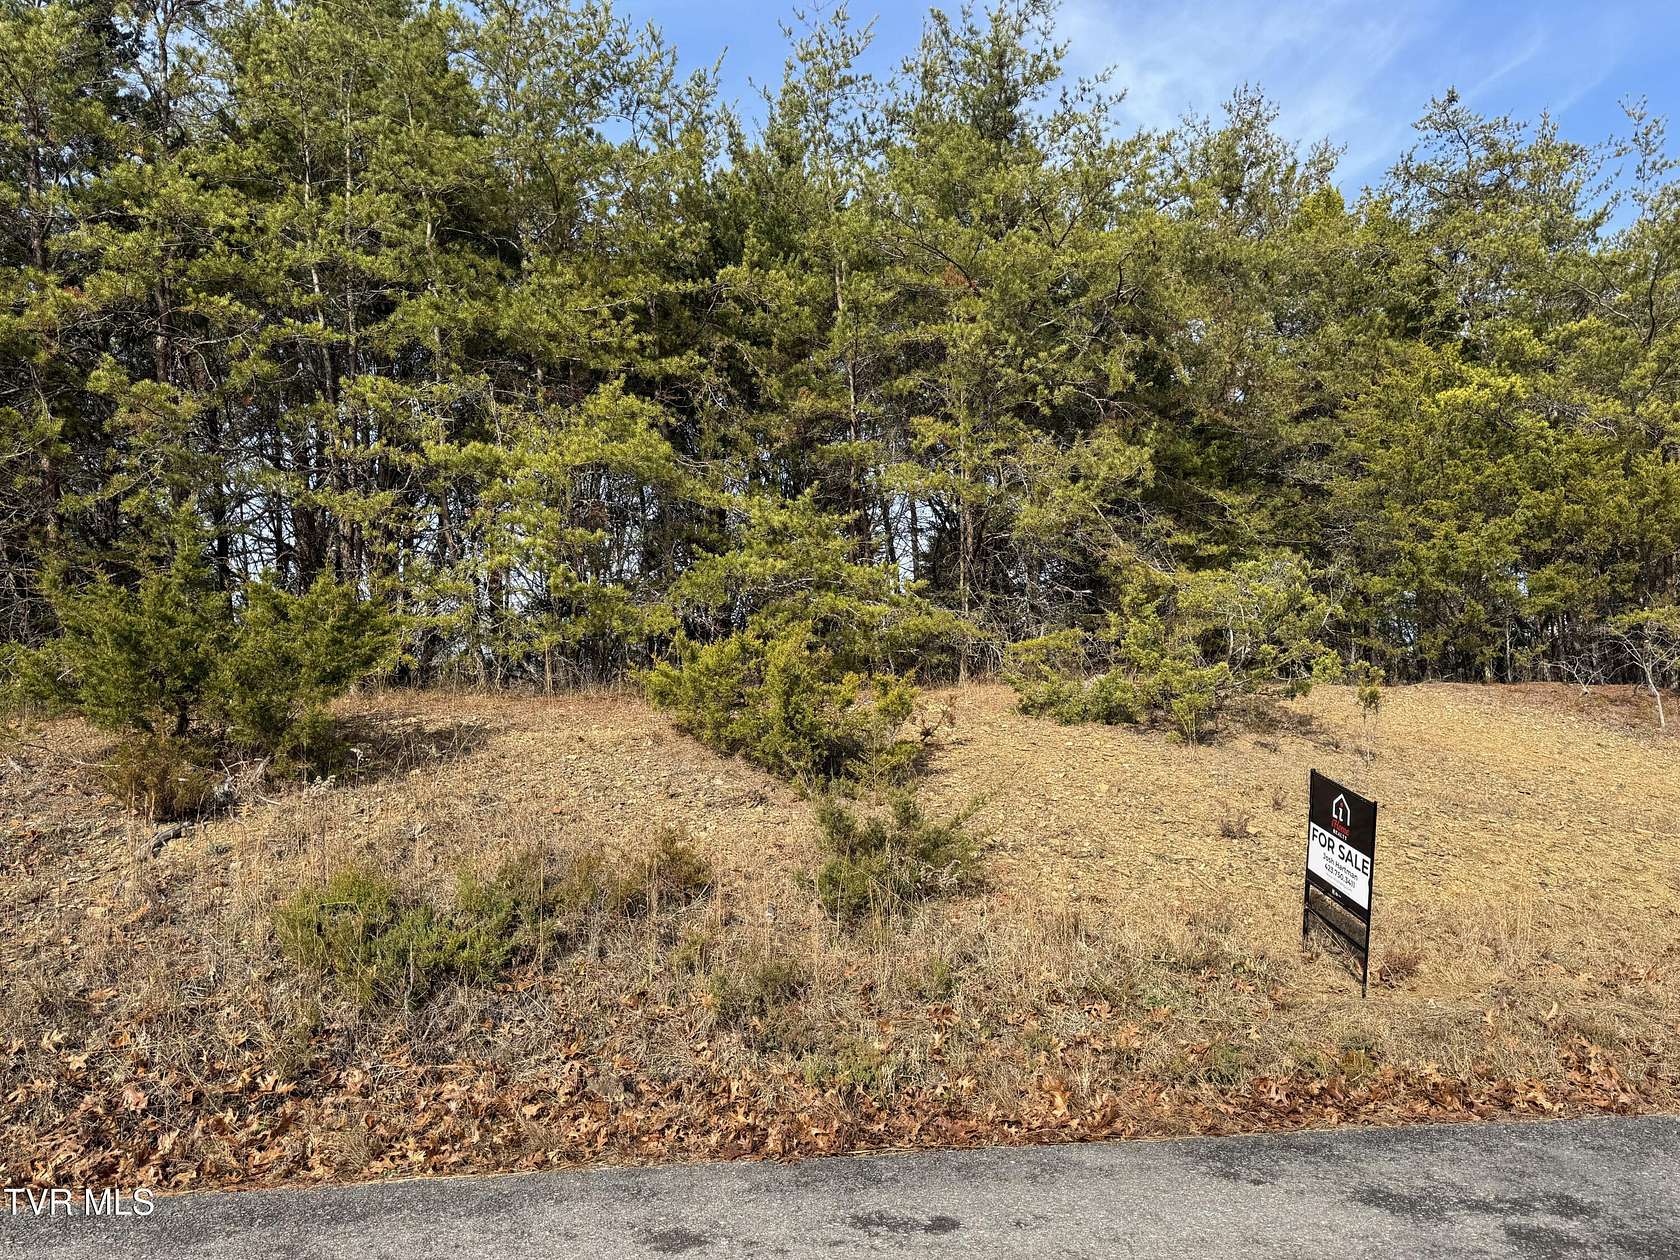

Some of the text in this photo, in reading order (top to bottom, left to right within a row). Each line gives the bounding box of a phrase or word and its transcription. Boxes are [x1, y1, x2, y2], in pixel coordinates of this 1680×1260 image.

[1312, 827, 1369, 876] FOR SALE
[1323, 852, 1335, 865] Josh
